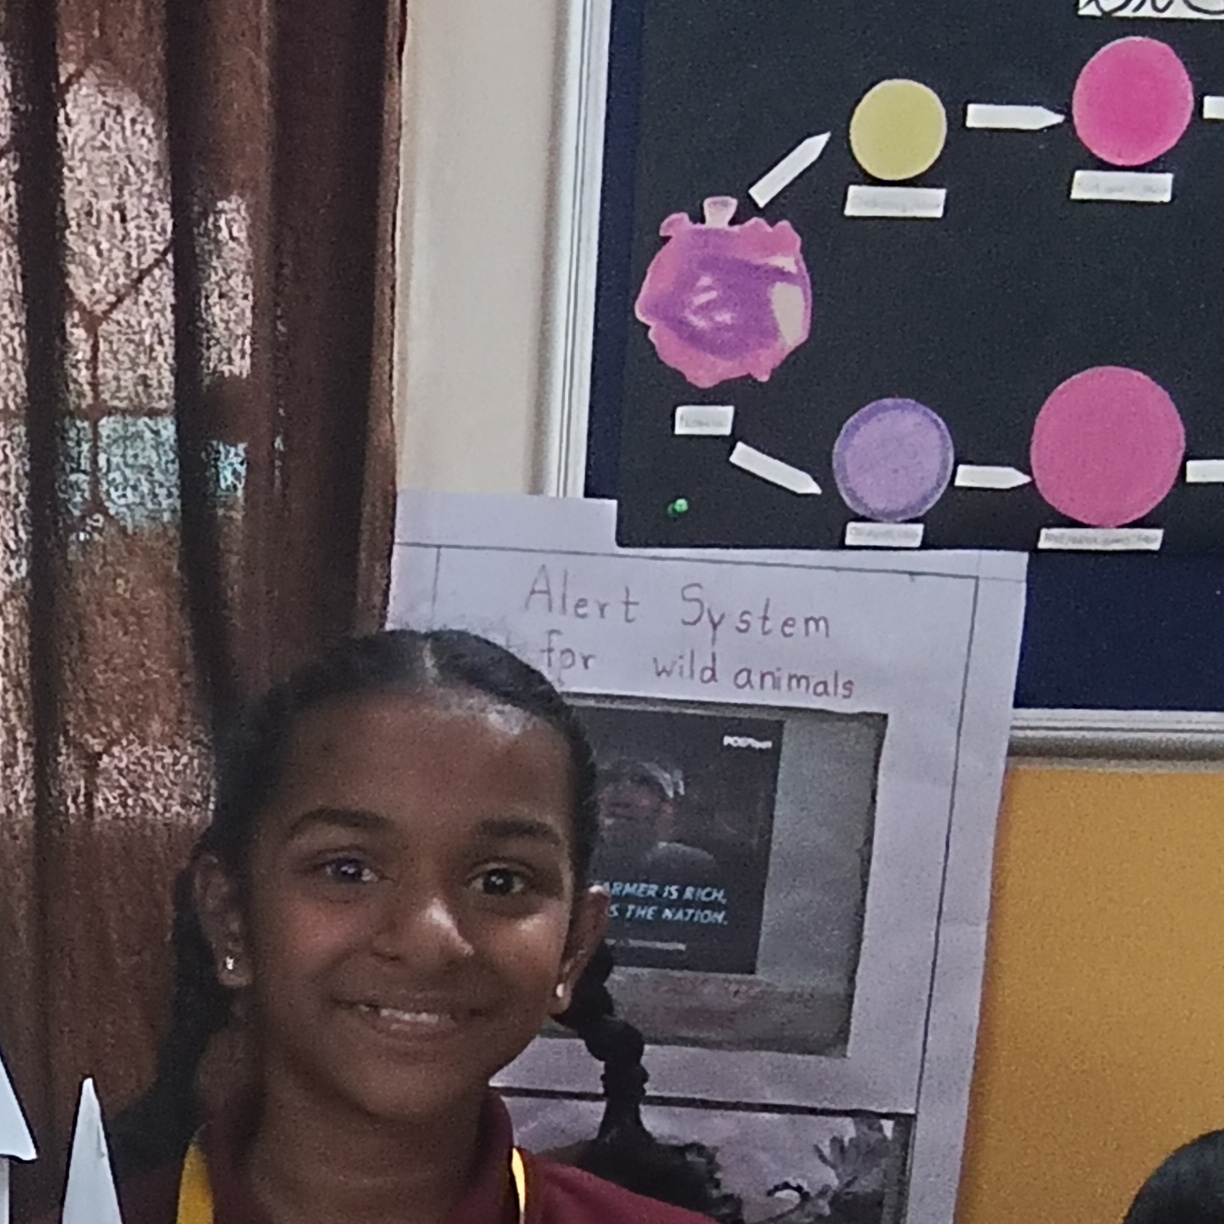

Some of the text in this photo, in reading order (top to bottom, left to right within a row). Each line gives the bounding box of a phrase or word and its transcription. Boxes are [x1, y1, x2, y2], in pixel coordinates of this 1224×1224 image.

[526, 564, 830, 646] Alert System
[652, 649, 718, 685] wild
[733, 664, 854, 700] animals
[602, 881, 658, 898] ARMER
[662, 885, 679, 900] IS
[607, 903, 729, 925] S THE NATION.
